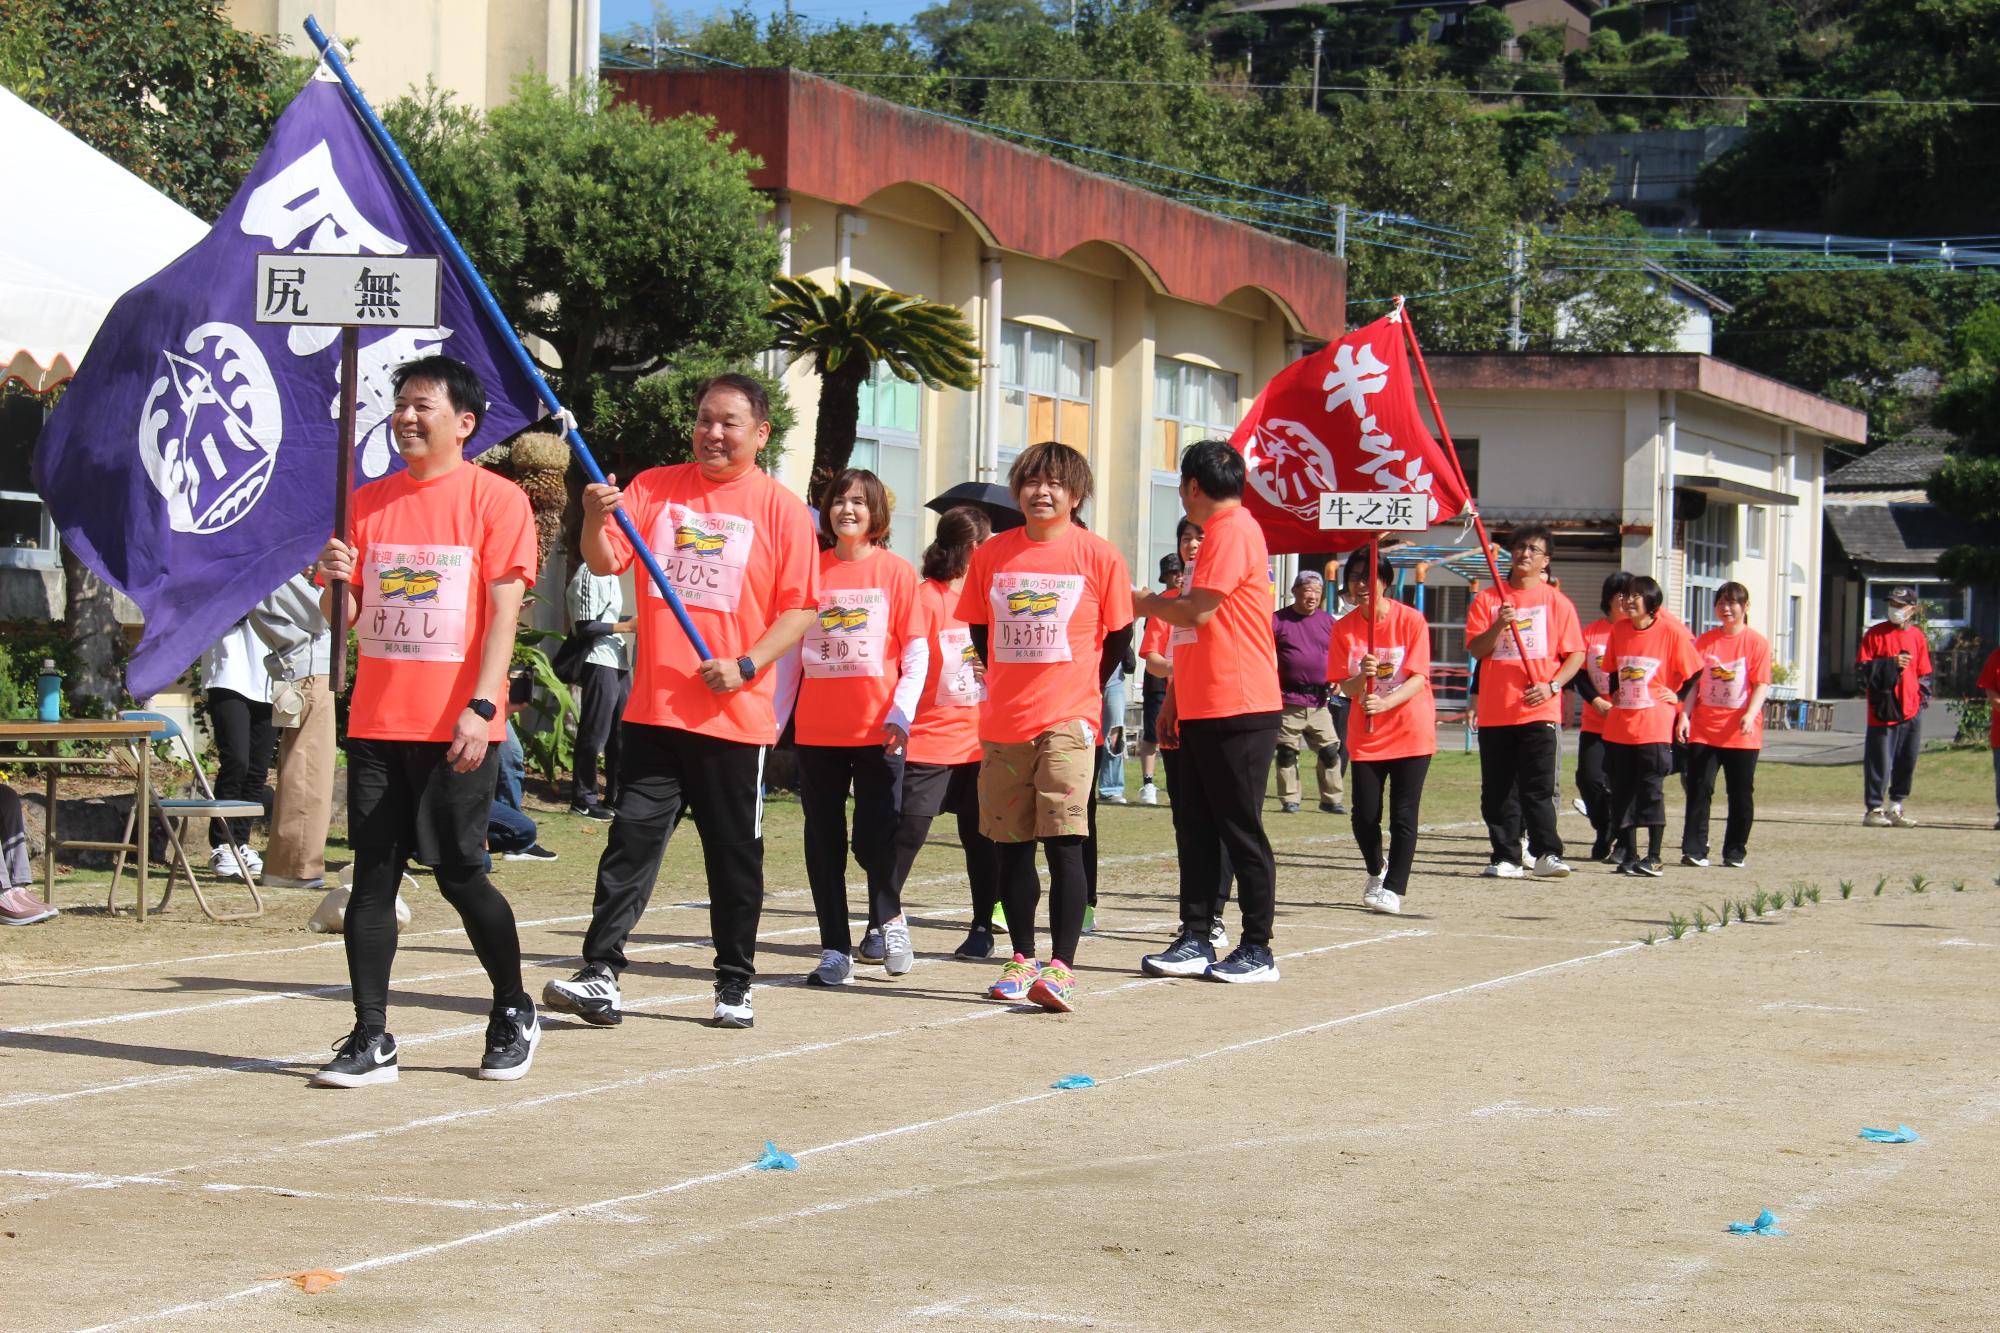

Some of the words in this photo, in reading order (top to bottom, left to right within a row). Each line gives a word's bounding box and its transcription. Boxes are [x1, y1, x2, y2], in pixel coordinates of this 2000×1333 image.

[264, 266, 401, 319] 尻無
[1325, 496, 1413, 526] 牛之浜
[395, 551, 462, 567] 華の50歳組
[1020, 578, 1076, 590] 華の50歳組
[373, 608, 438, 638] けんし
[1003, 623, 1058, 646] りょうすけ
[820, 640, 869, 661] まゆこ
